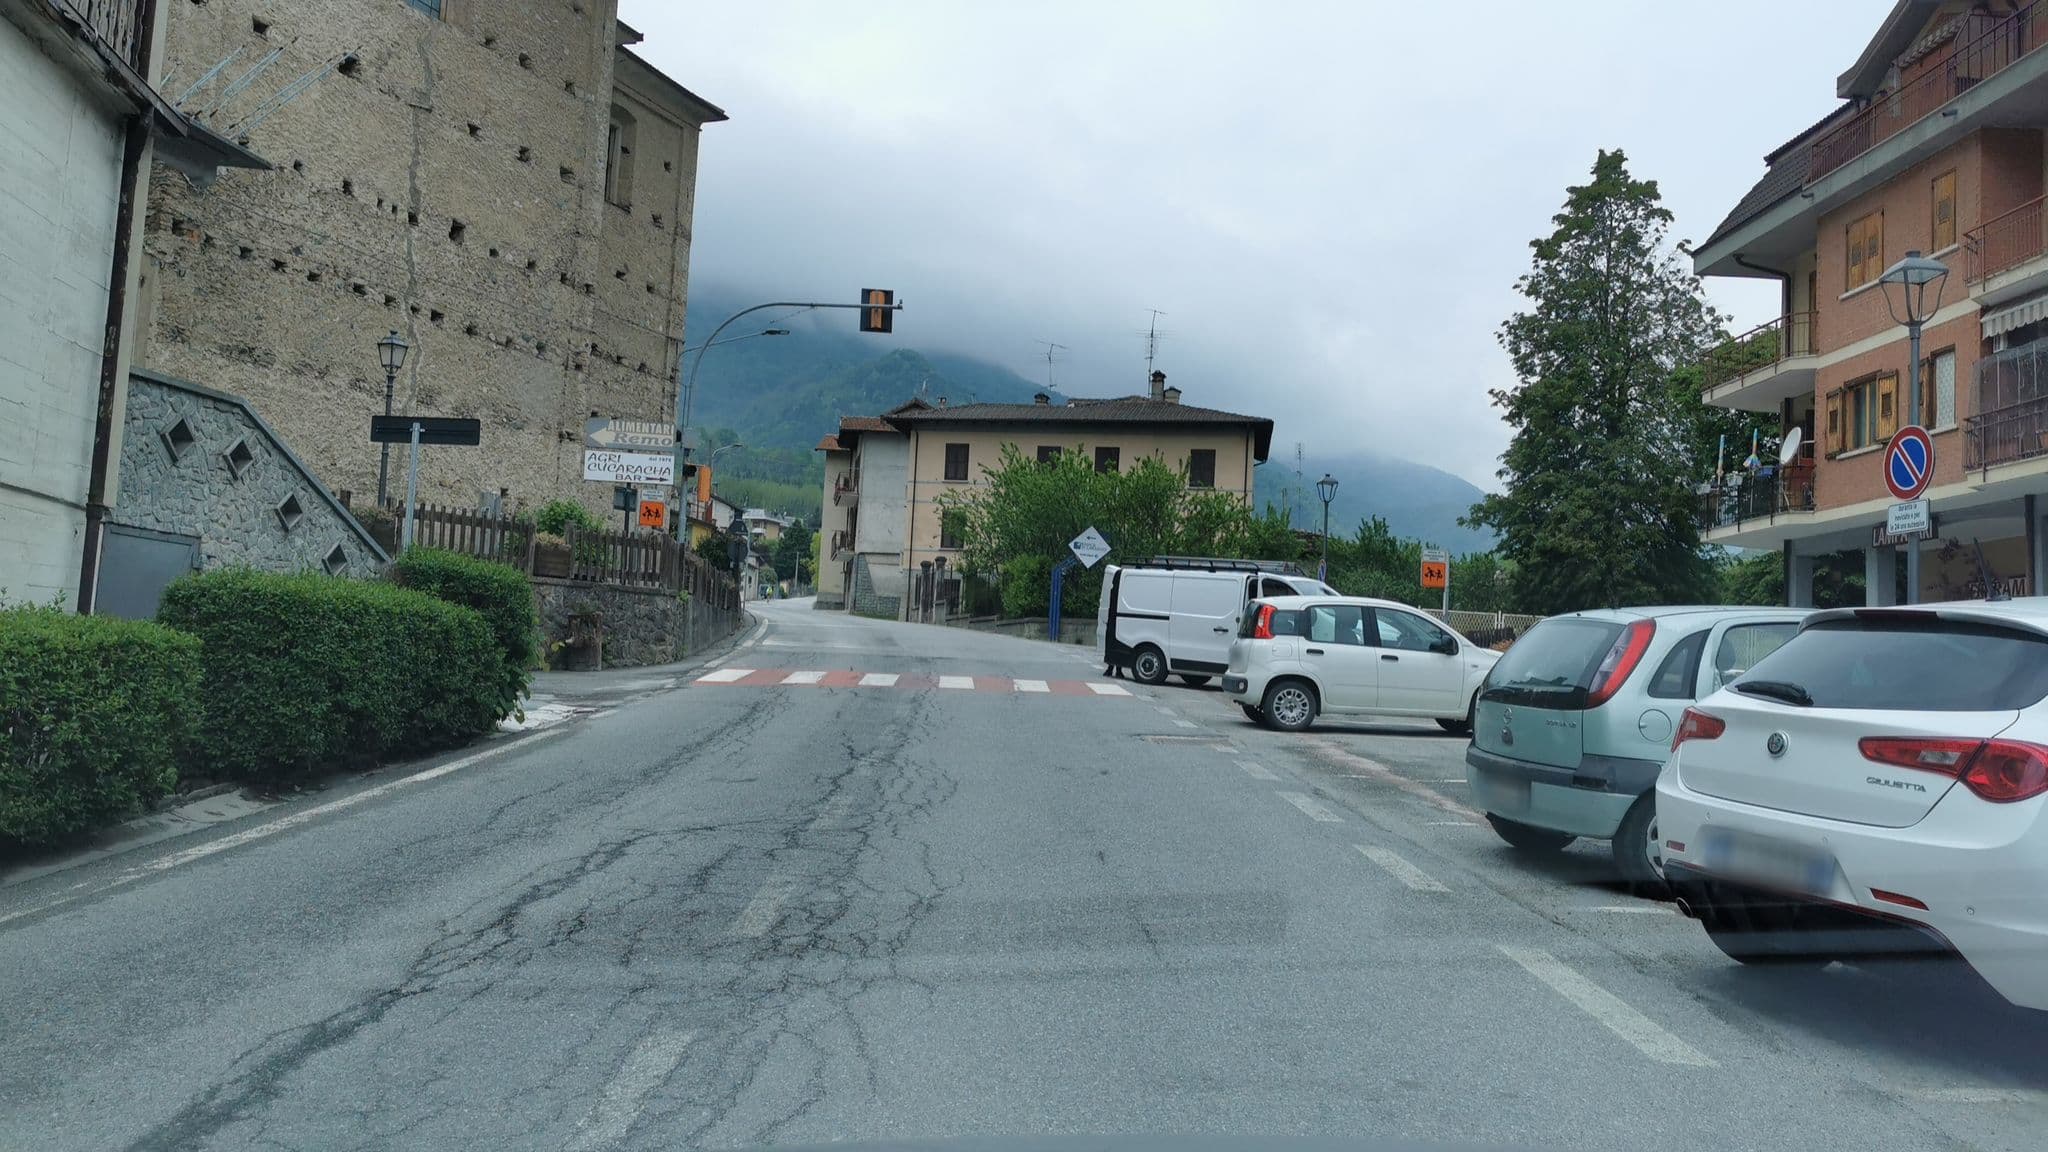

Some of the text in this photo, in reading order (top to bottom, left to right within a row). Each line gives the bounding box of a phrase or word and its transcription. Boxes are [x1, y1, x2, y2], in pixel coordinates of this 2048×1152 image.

[607, 419, 674, 435] ALIMENTARI
[614, 433, 673, 446] Remo
[588, 452, 621, 463] AGRI
[587, 462, 671, 477] CUCARACHA
